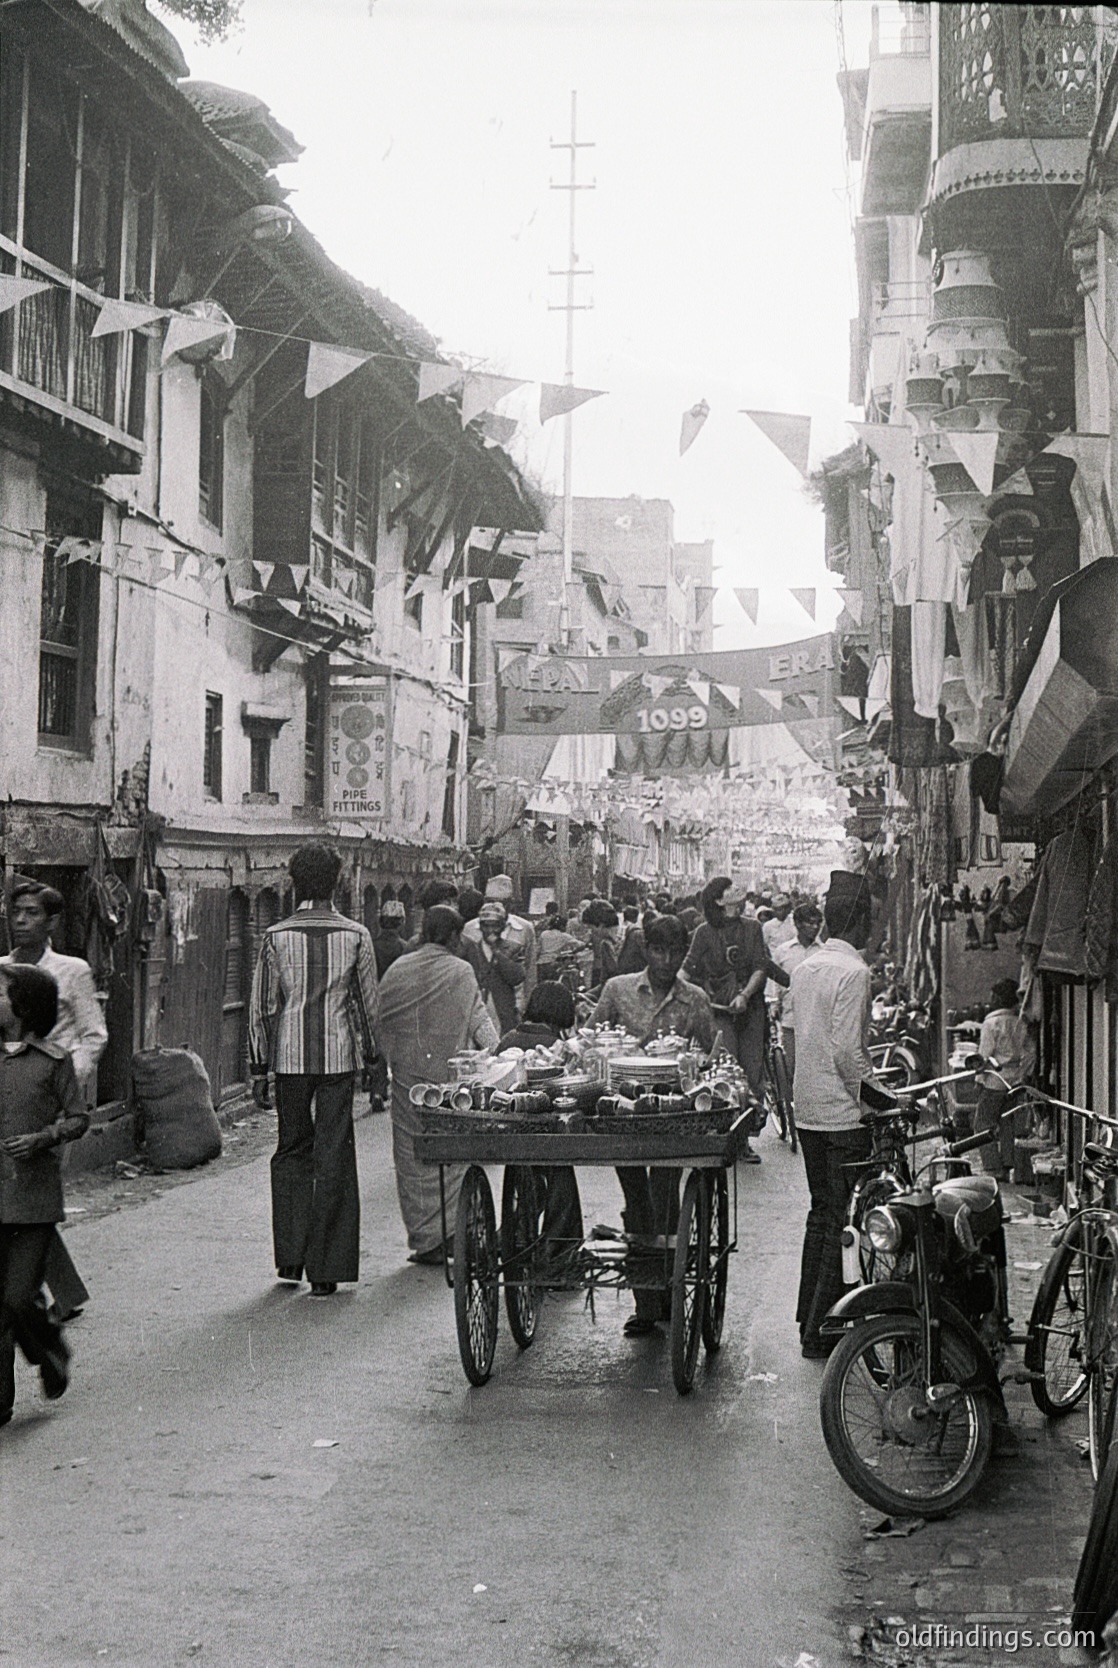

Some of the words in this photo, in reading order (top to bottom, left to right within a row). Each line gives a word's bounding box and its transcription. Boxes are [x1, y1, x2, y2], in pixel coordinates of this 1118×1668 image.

[501, 662, 602, 694] NEPAL
[768, 645, 835, 682] ERA
[362, 692, 385, 704] QUALITY
[635, 705, 708, 733] 1099
[342, 789, 367, 800] PIPE
[333, 801, 381, 812] FITTINGS
